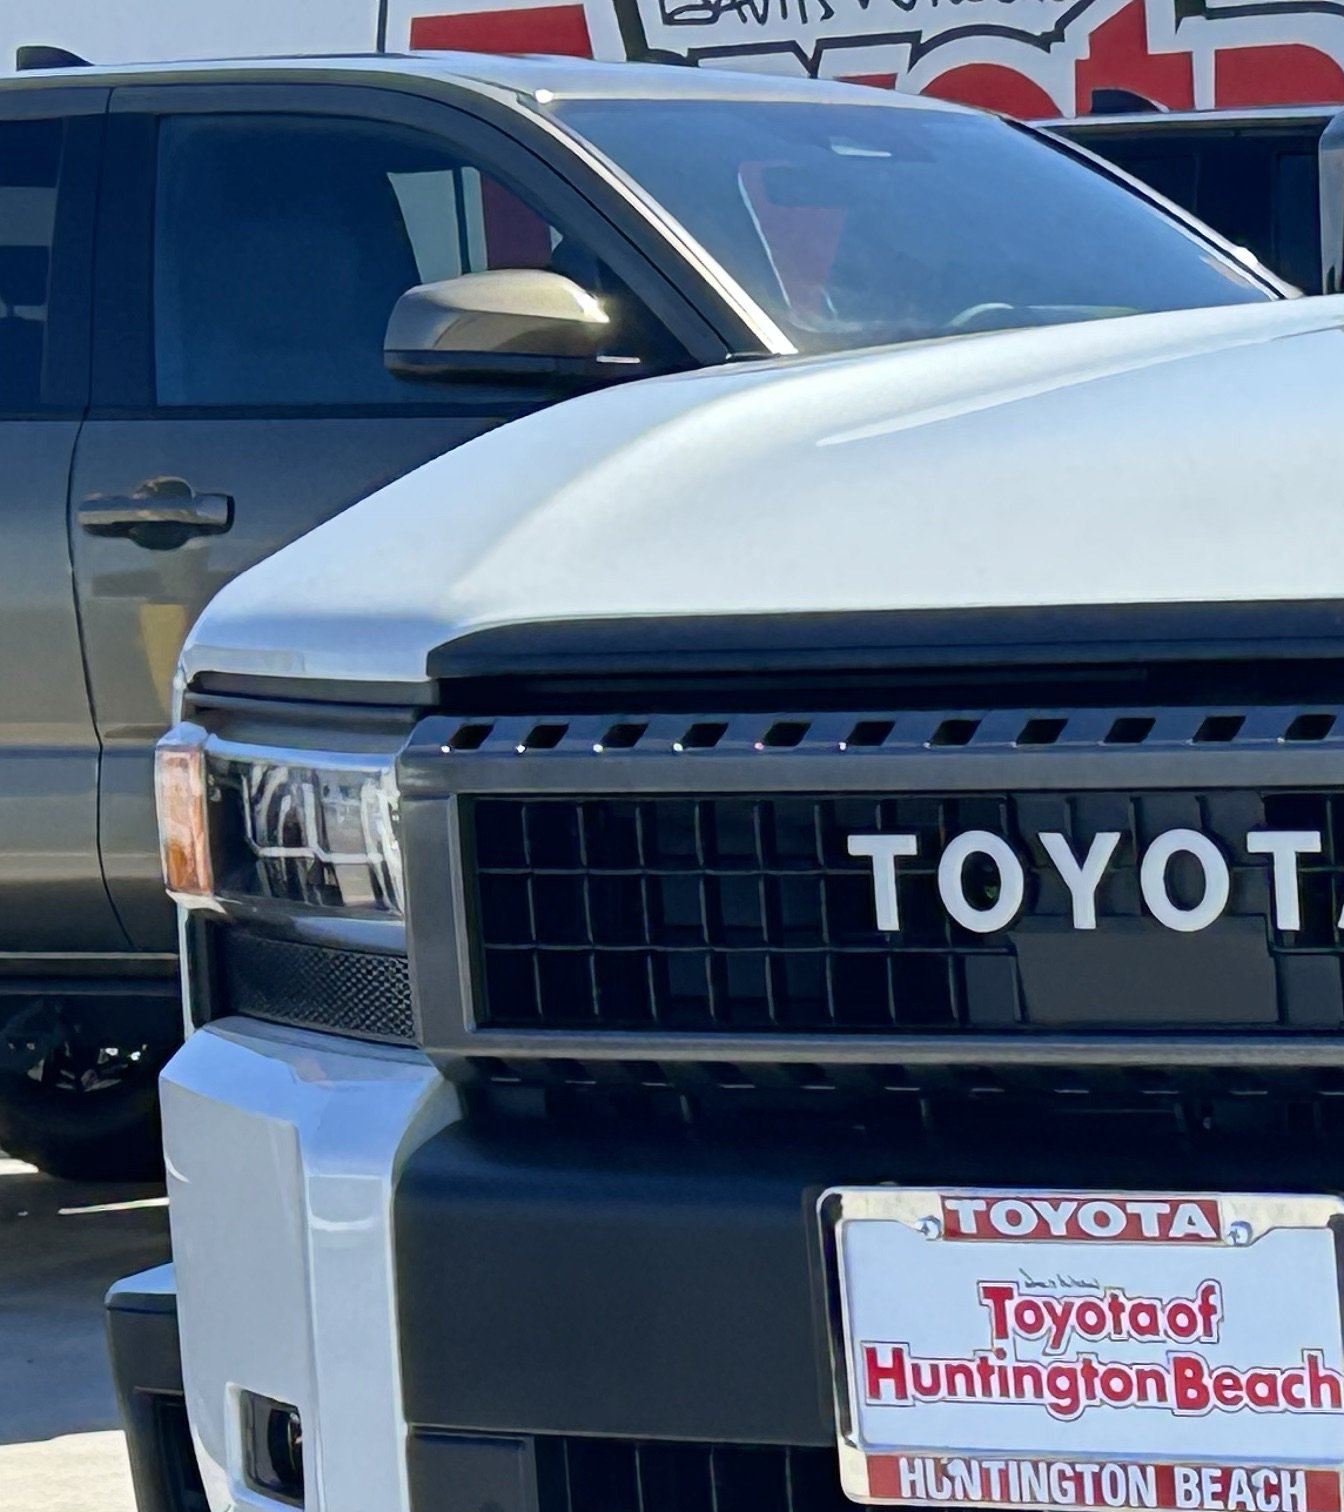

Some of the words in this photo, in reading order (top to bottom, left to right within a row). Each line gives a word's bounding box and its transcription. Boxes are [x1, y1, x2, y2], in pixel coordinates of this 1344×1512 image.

[945, 1199, 1218, 1240] TOYOTA
[982, 1284, 1161, 1350] Toyota
[1166, 1281, 1219, 1339] of
[864, 1346, 1167, 1416] Huntington
[1173, 1352, 1343, 1411] Beach
[899, 1456, 1160, 1508] HUNTINGTON
